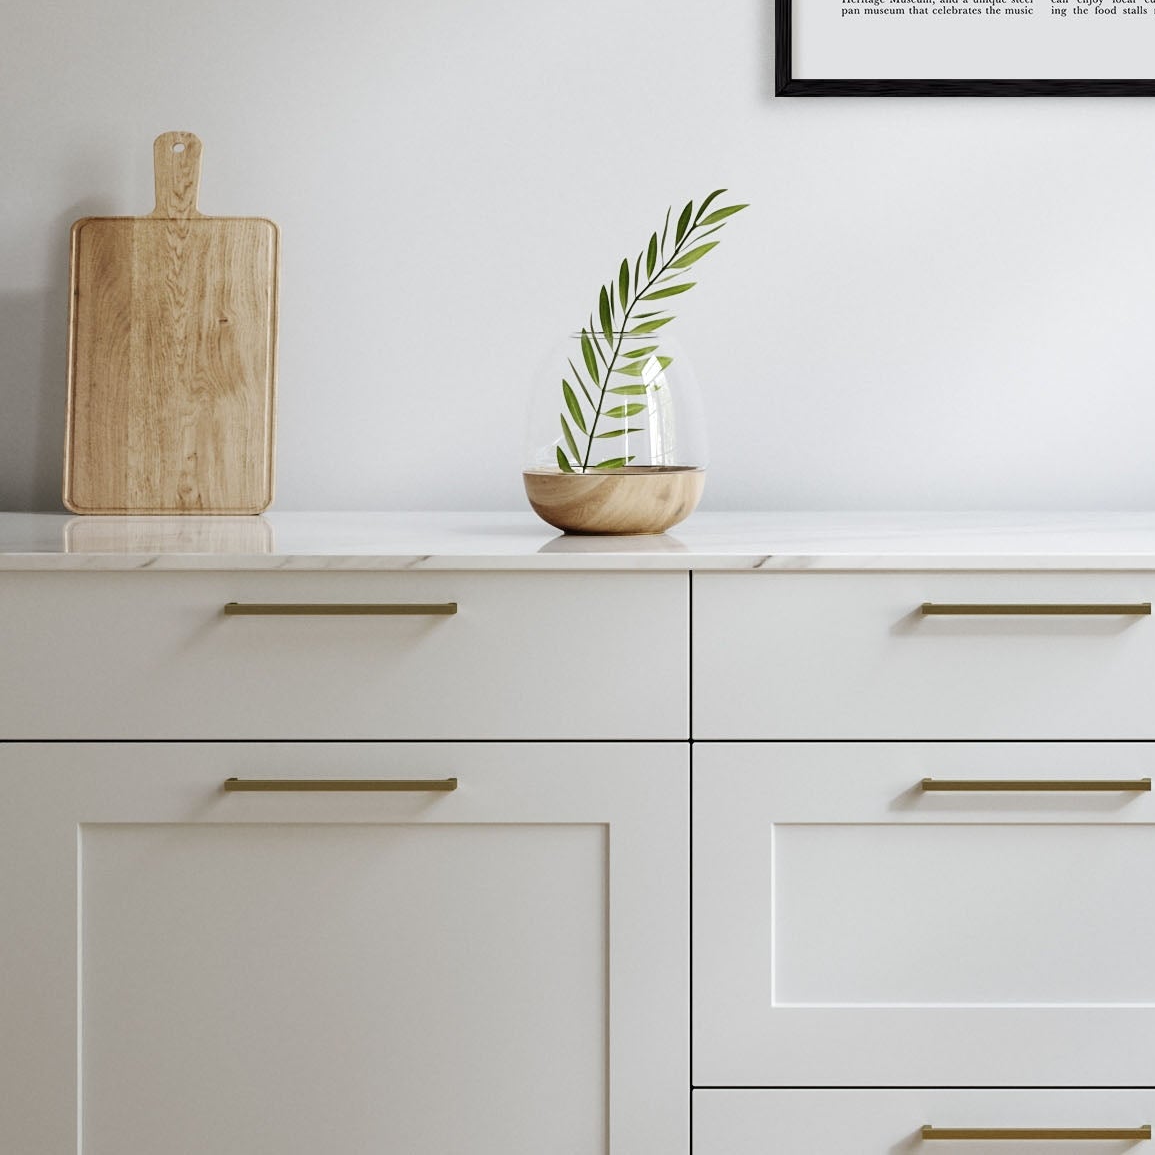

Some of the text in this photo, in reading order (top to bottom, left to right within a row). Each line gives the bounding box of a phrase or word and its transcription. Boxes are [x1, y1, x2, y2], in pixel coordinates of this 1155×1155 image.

[842, 8, 860, 17] pan
[909, 6, 928, 15] that
[932, 6, 982, 15] celebrates
[986, 6, 1001, 15] the
[1005, 6, 1033, 15] music
[1051, 6, 1067, 17] ing
[1073, 6, 1088, 15] the
[1095, 6, 1117, 15] food
[1123, 6, 1148, 15] stalls
